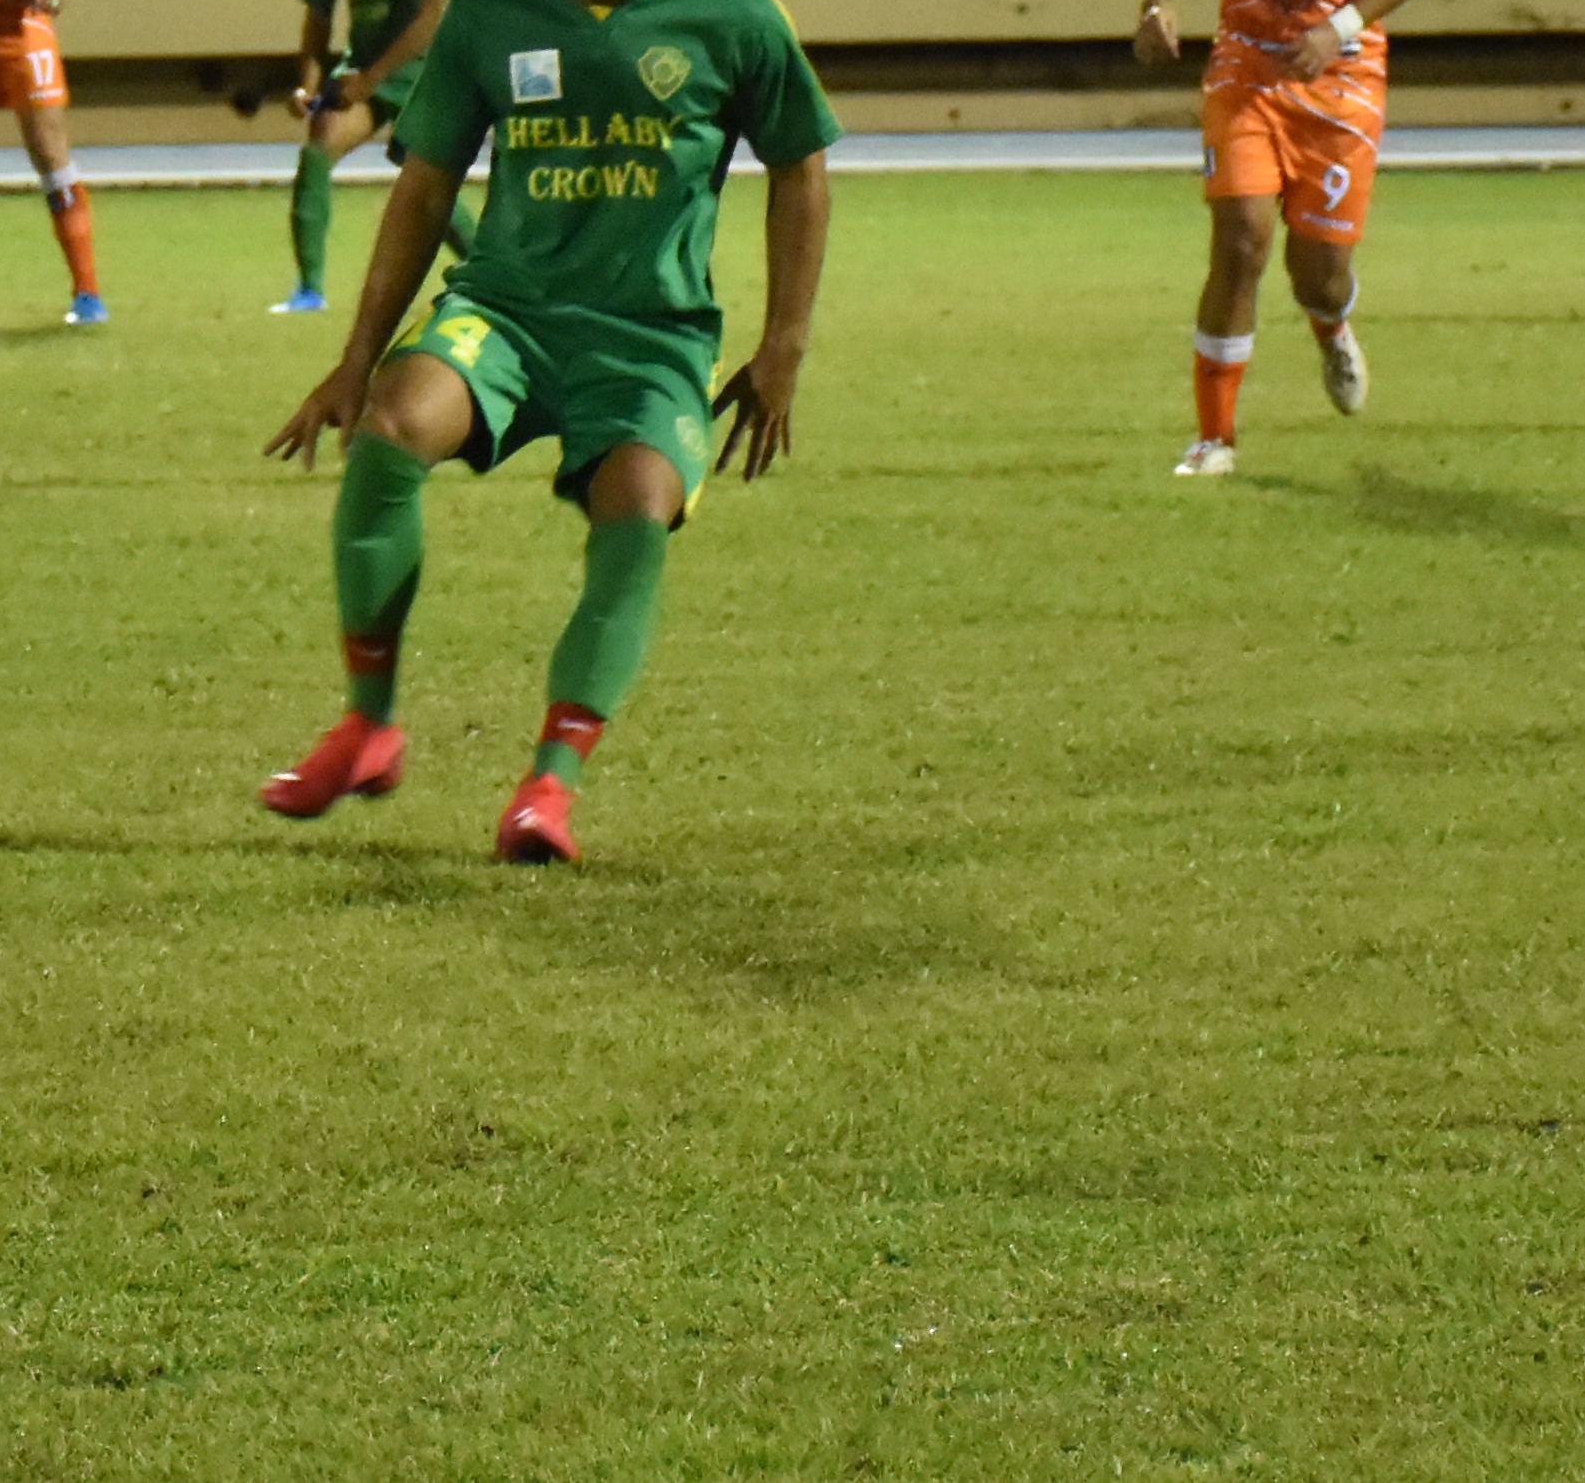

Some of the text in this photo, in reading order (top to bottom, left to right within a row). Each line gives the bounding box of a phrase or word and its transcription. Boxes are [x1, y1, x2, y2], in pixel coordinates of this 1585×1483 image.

[26, 50, 54, 86] 17
[507, 112, 684, 151] HELLABY
[527, 159, 660, 202] CROWN
[1322, 163, 1352, 213] 9
